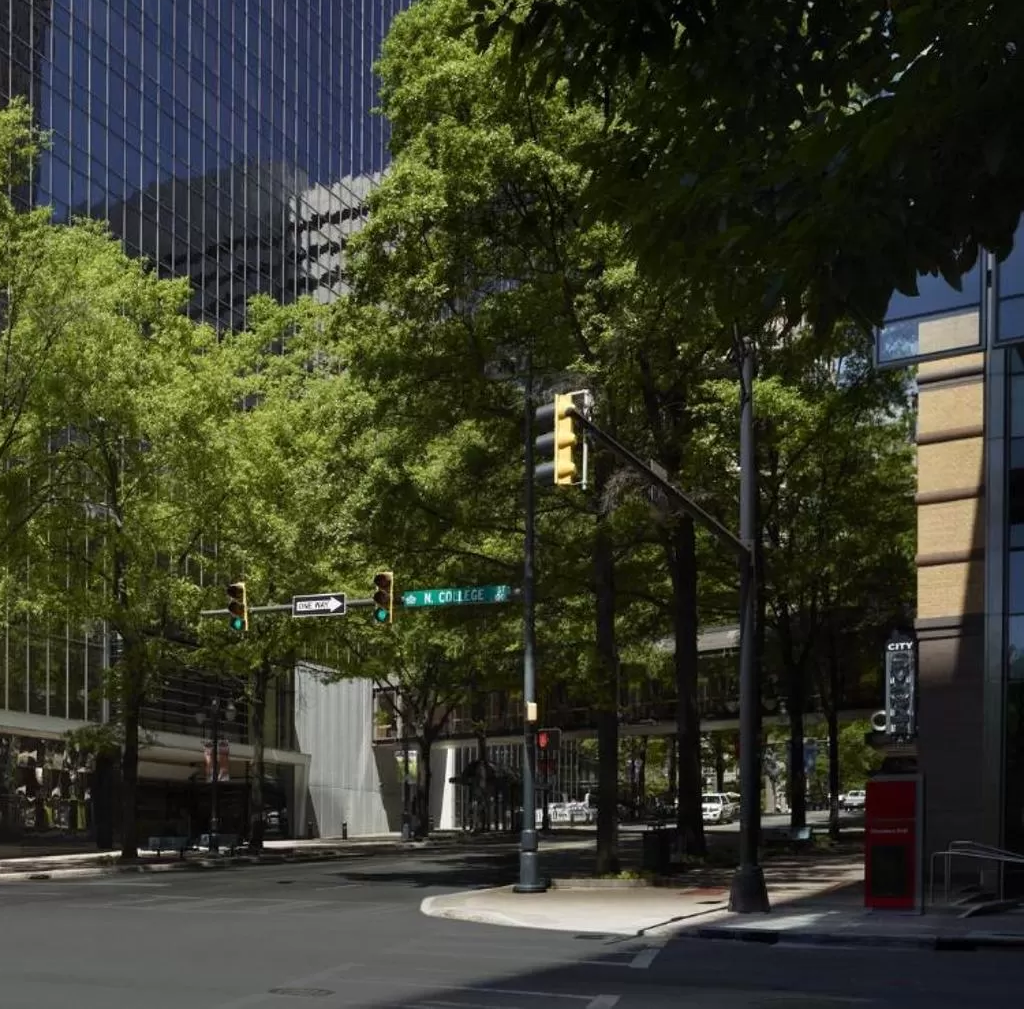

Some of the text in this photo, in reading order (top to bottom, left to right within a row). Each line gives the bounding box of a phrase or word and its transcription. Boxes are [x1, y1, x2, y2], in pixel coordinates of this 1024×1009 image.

[438, 589, 484, 603] COLLEGE
[298, 601, 329, 610] ONE WAY
[887, 642, 913, 651] CITY
